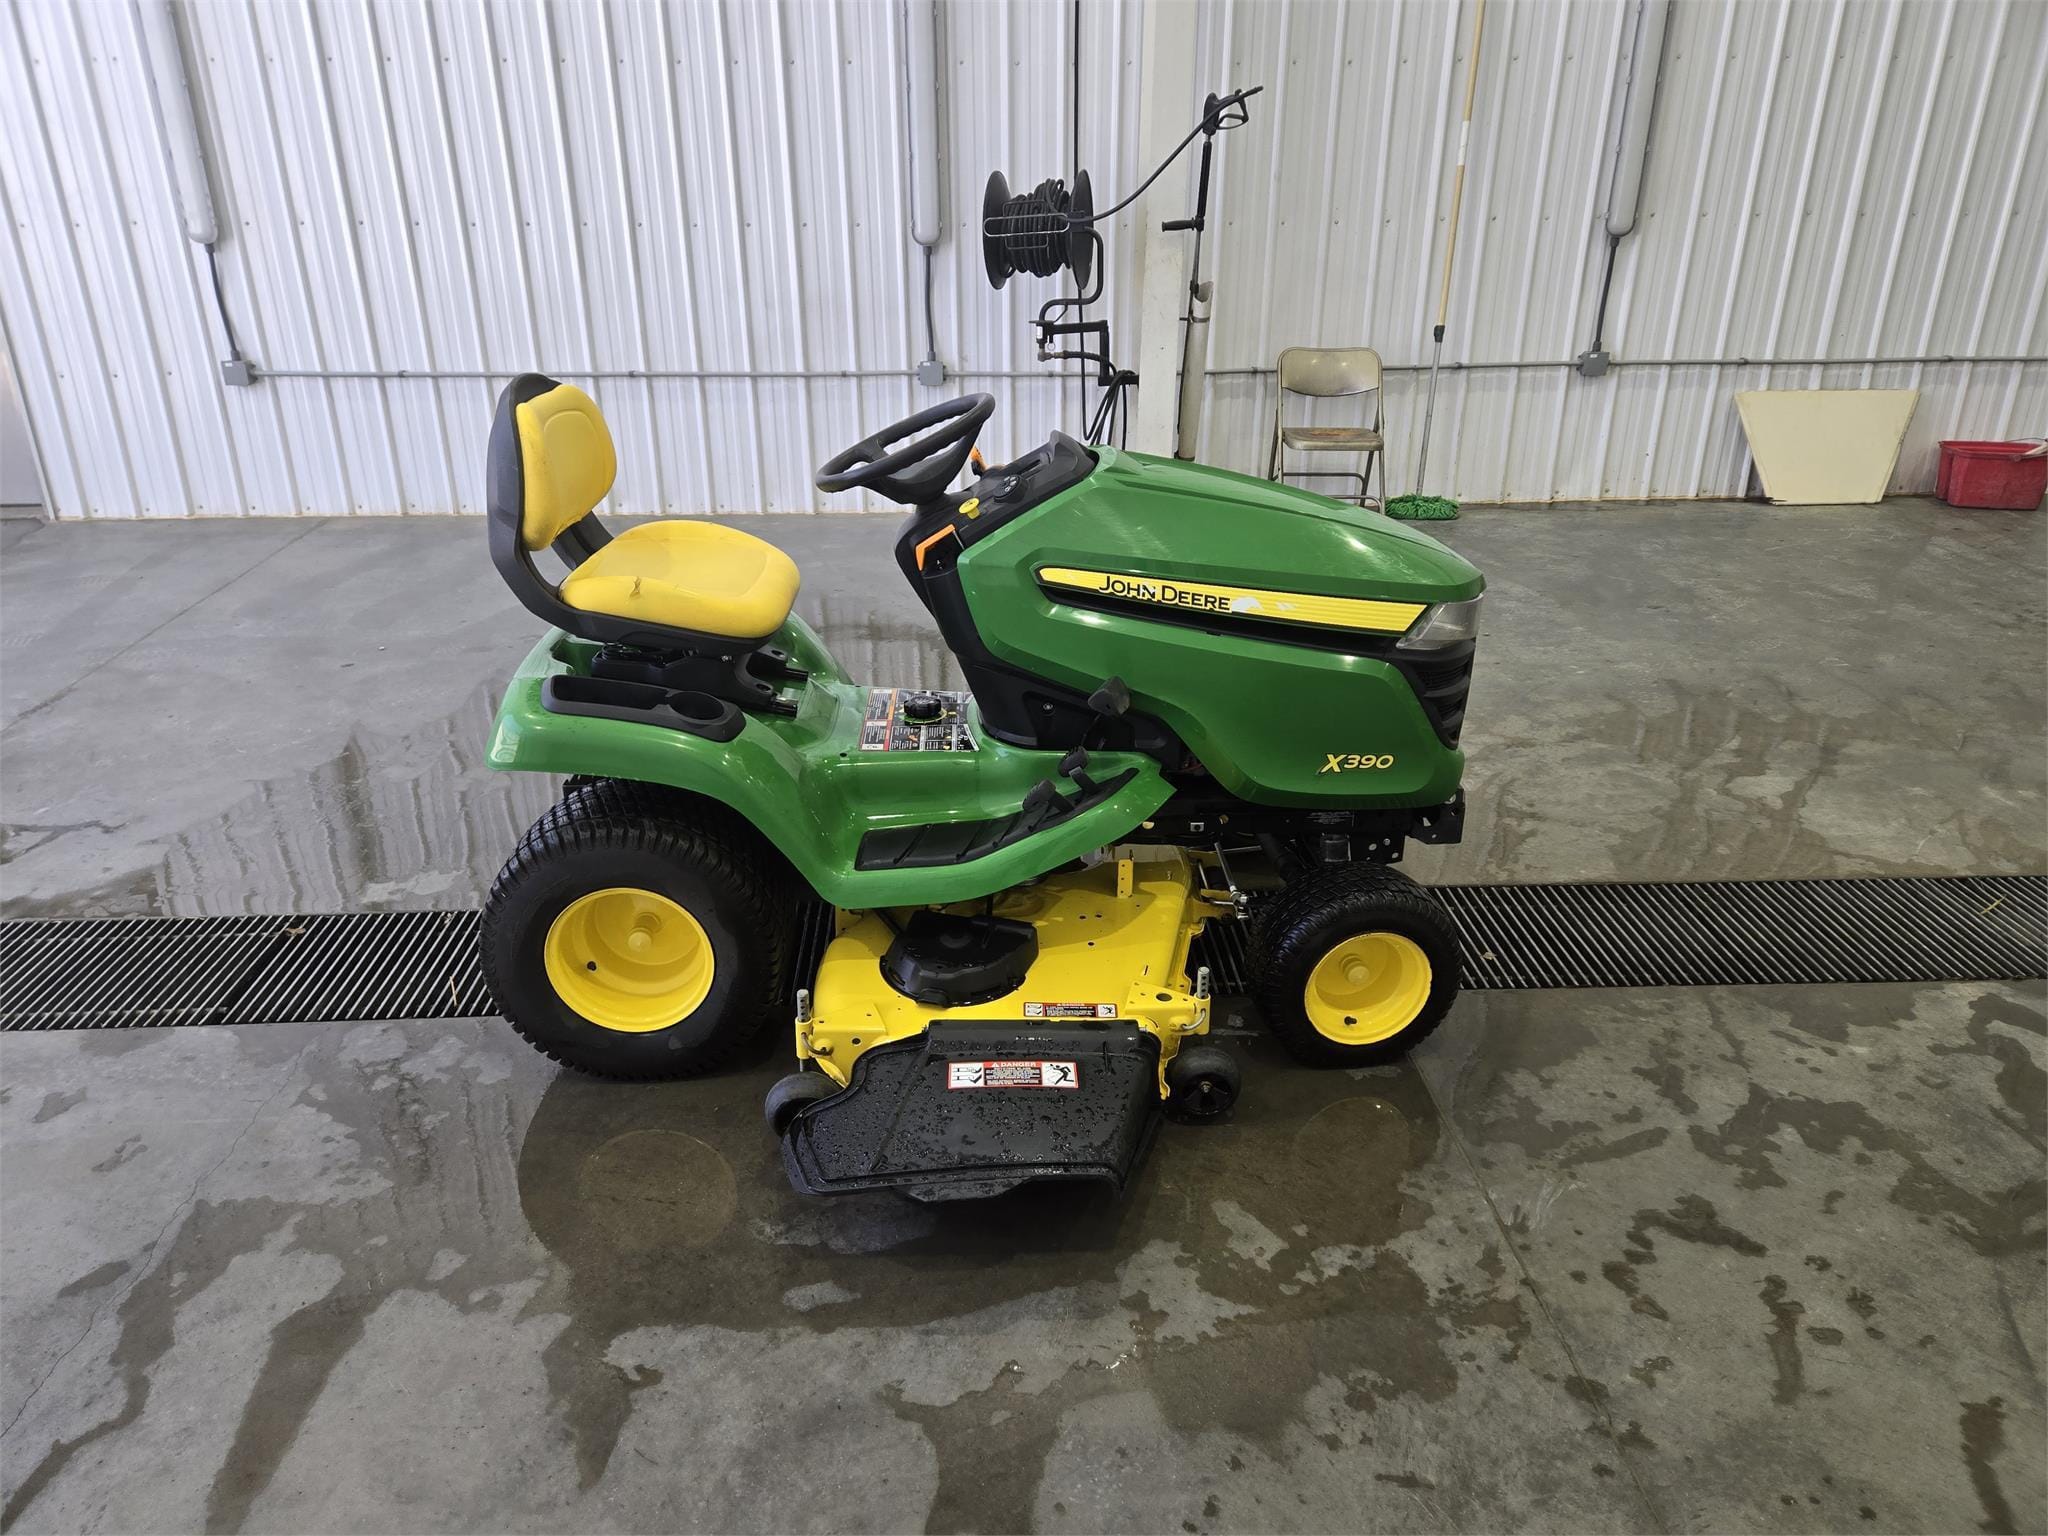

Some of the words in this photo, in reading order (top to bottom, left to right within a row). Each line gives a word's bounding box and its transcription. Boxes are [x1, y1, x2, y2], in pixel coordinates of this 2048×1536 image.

[1099, 575, 1156, 599] JOHN
[1161, 584, 1231, 611] DEERE
[1320, 753, 1395, 773] X390
